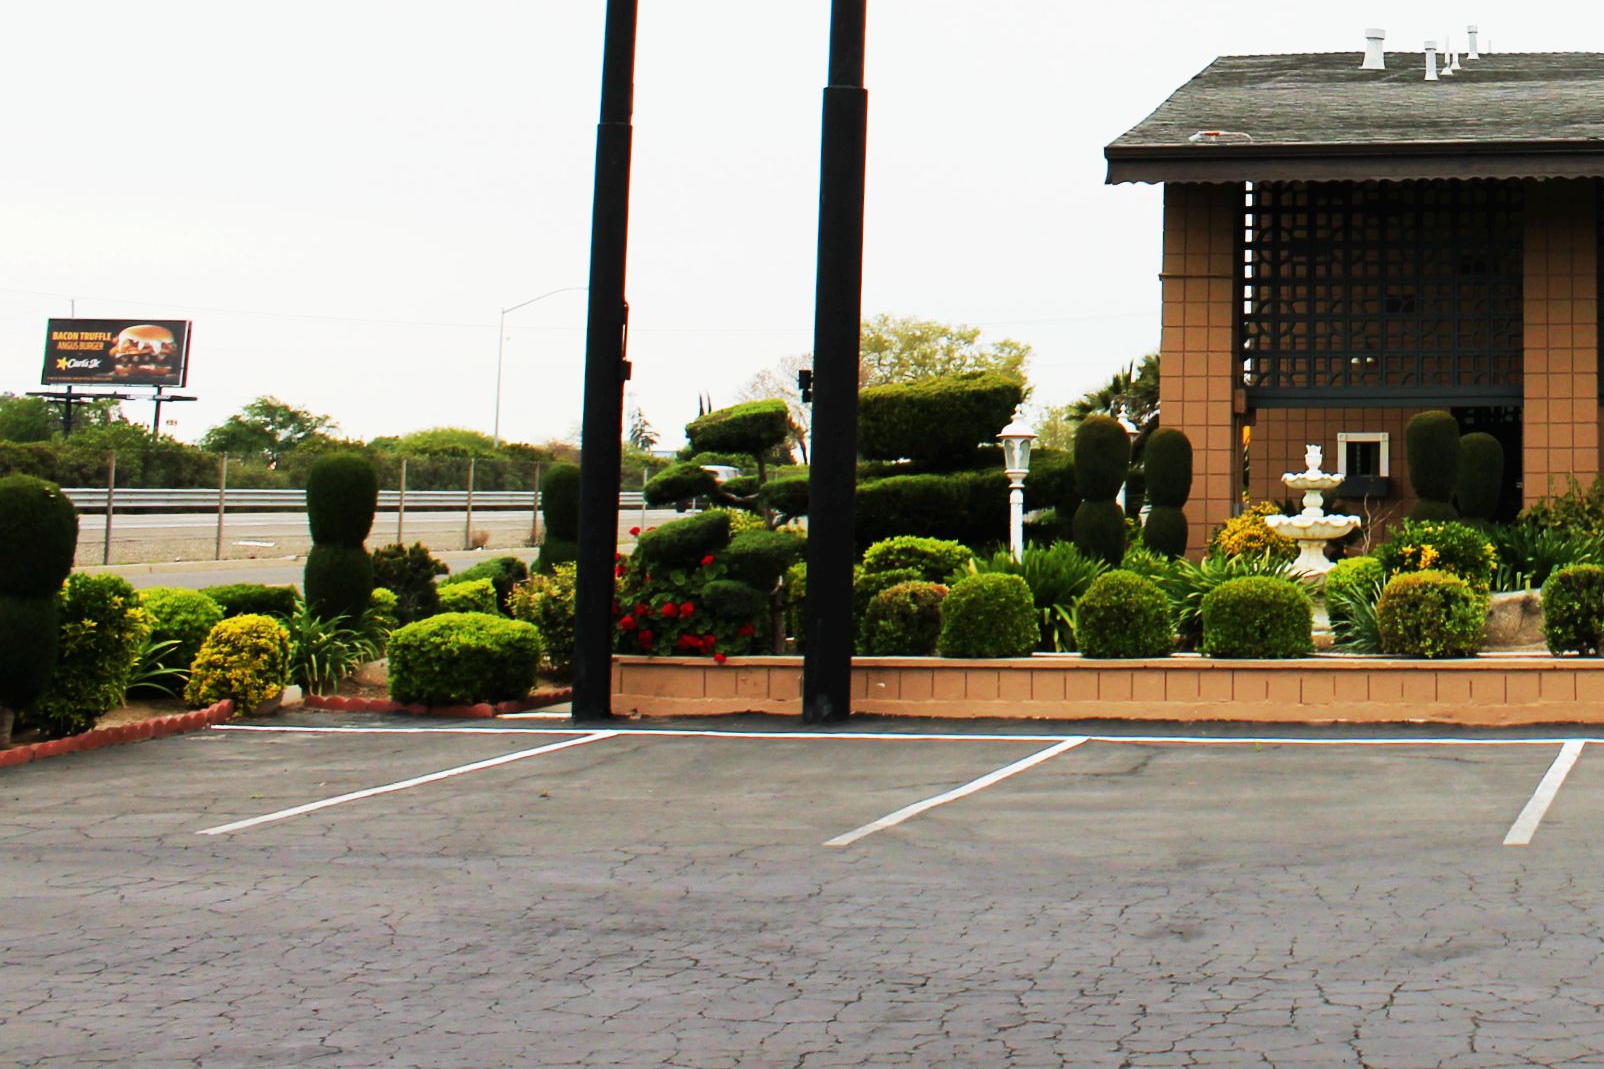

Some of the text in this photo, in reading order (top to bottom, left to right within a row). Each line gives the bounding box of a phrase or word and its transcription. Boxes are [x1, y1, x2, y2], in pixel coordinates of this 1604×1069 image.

[52, 331, 112, 341] BACON TRUFFLE
[56, 341, 104, 350] ANGUS BURGER
